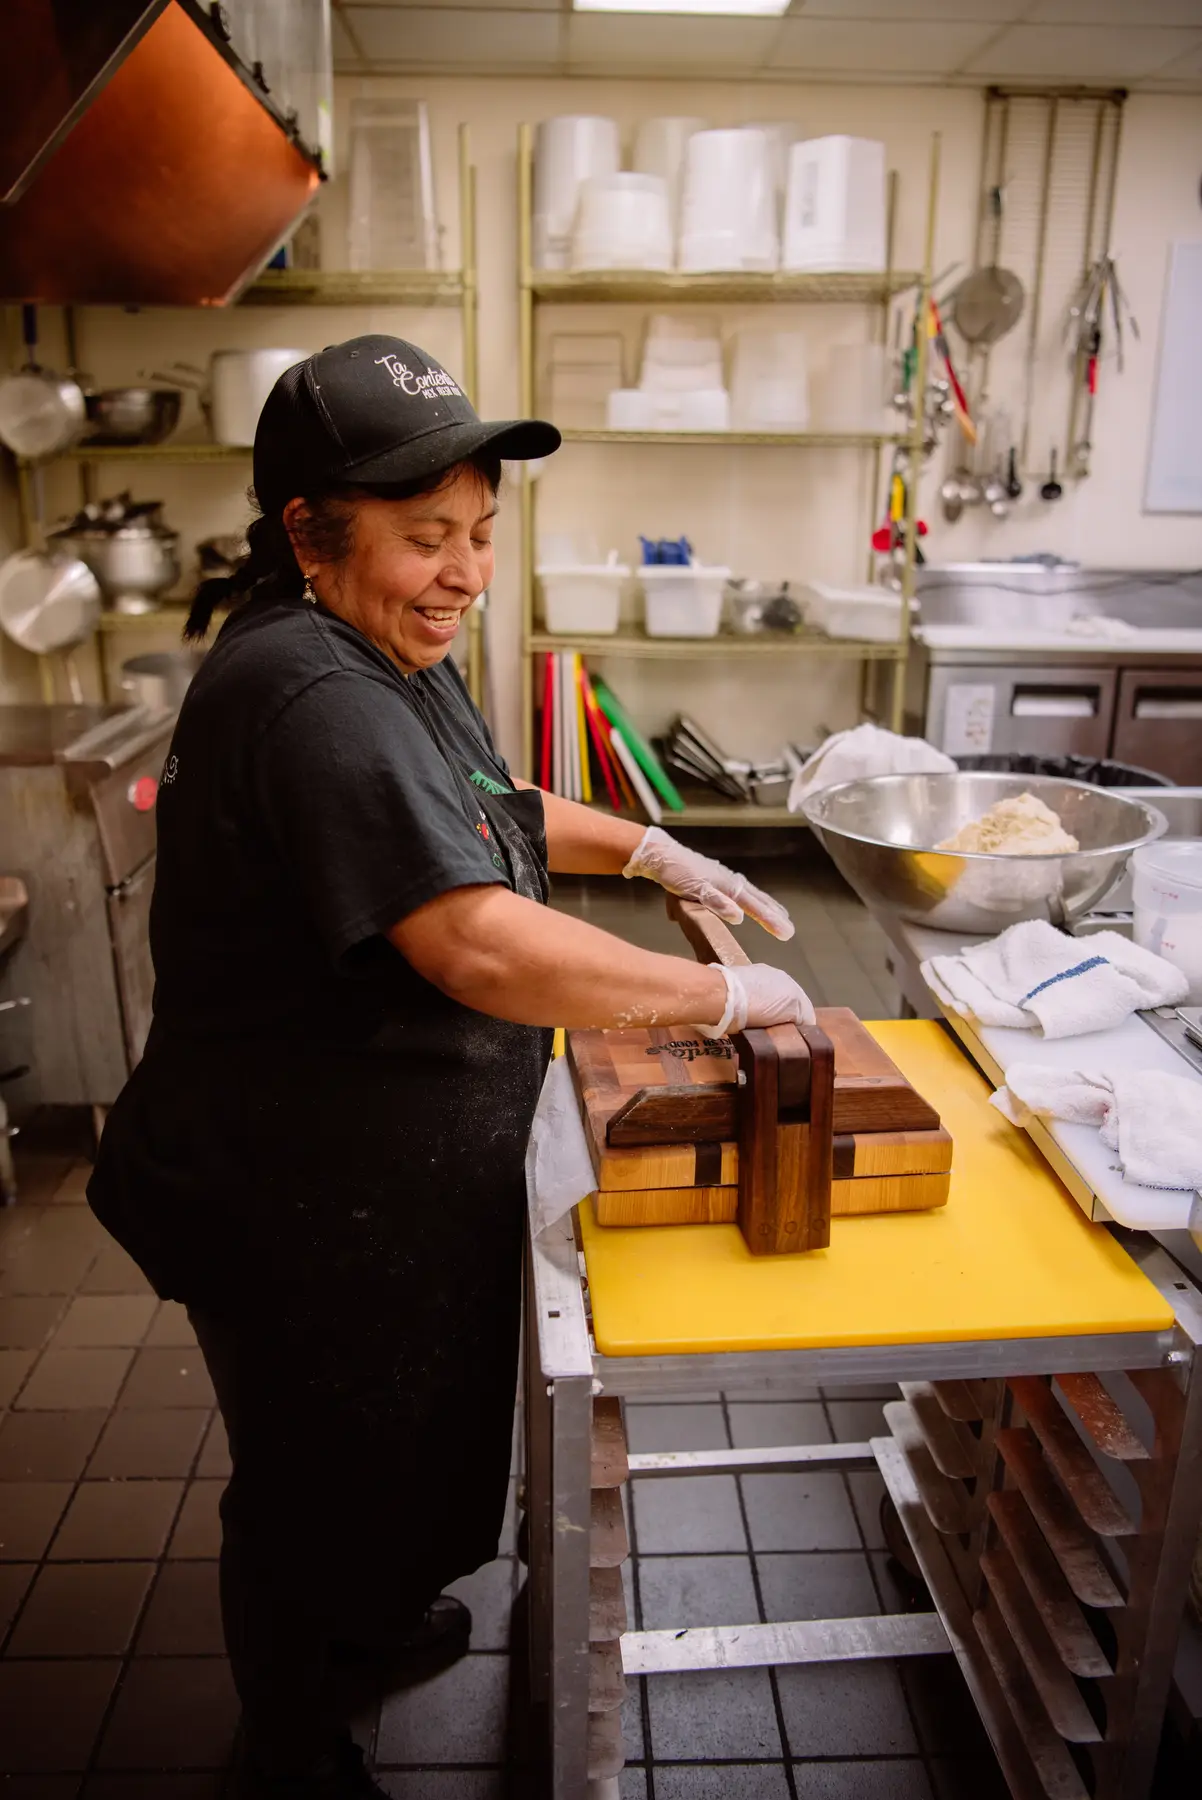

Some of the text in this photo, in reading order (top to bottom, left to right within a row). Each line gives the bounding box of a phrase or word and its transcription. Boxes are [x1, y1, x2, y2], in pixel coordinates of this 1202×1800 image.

[374, 354, 407, 380] Ta
[422, 387, 439, 399] MEX
[668, 1038, 733, 1048] RESH FOOD
